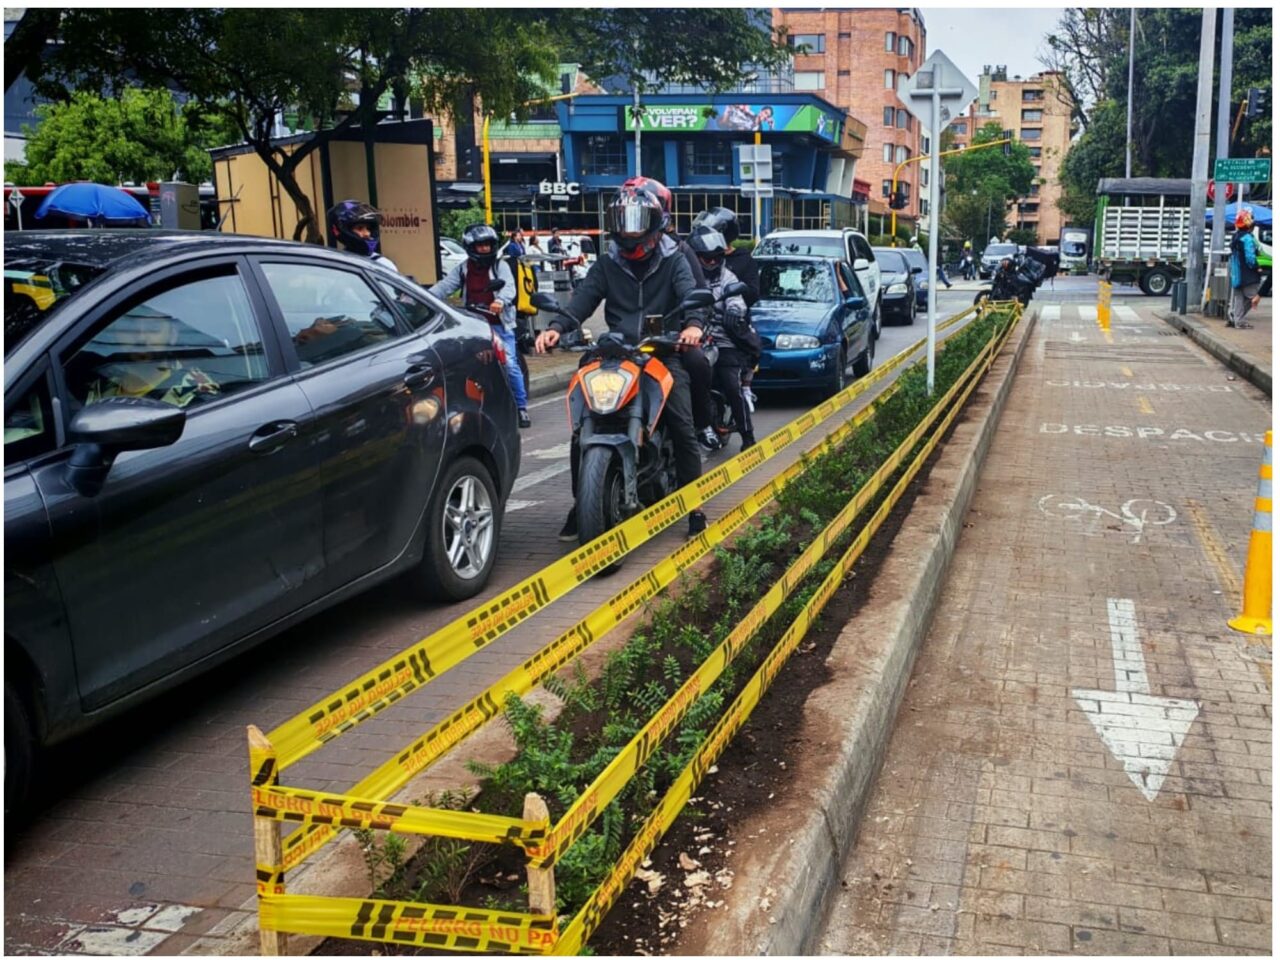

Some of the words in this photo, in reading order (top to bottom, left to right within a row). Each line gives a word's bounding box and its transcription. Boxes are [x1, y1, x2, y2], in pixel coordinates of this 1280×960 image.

[647, 114, 698, 128] VER?
[394, 915, 483, 938] PELIGRO
[489, 921, 521, 944] NO
